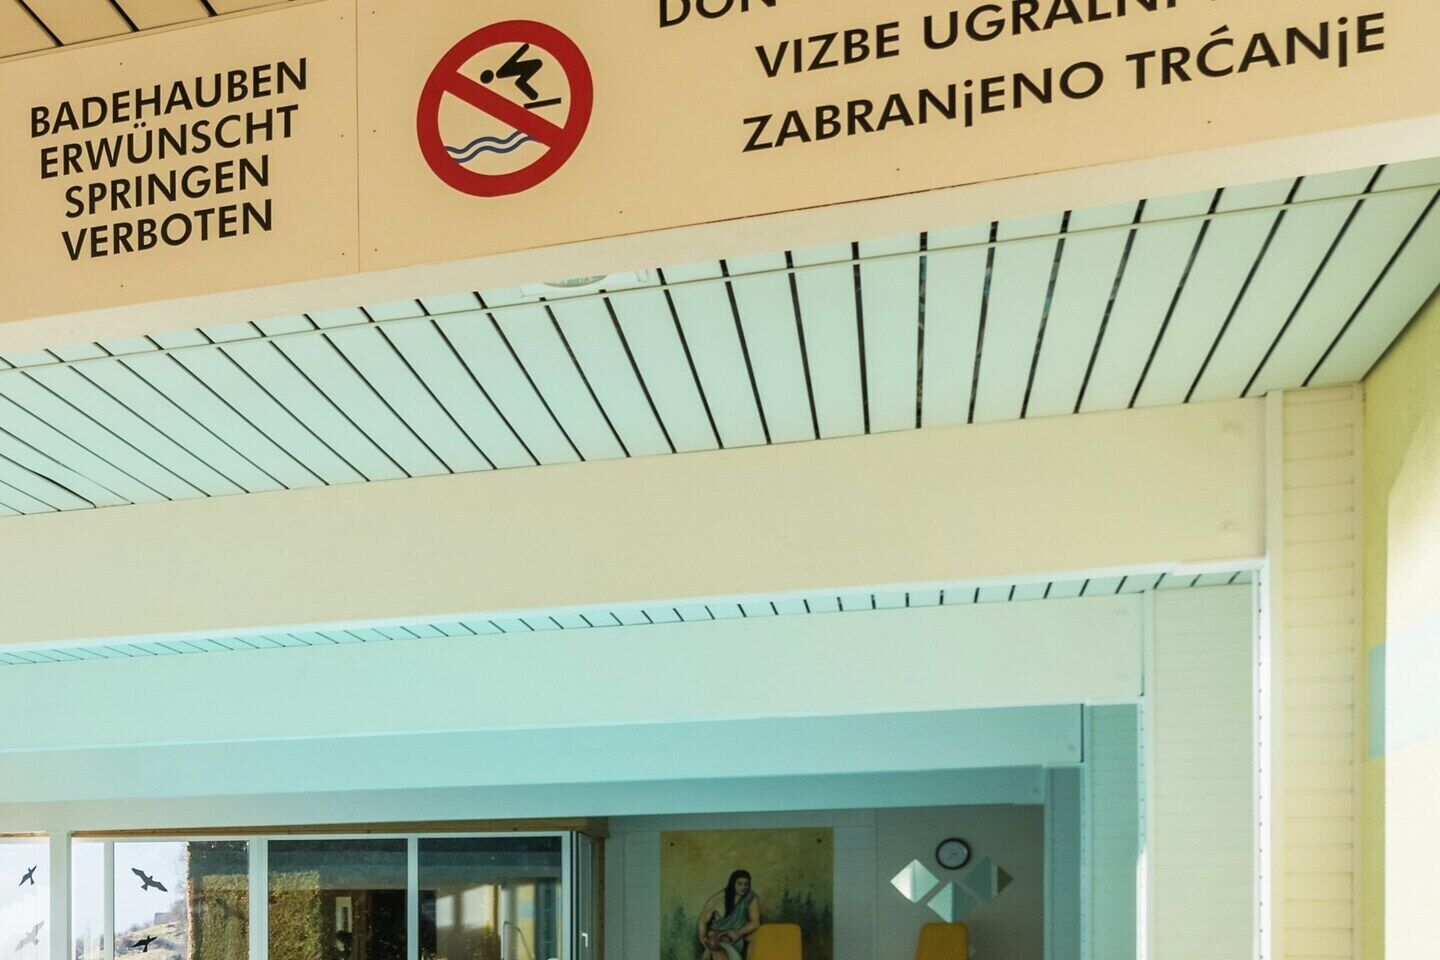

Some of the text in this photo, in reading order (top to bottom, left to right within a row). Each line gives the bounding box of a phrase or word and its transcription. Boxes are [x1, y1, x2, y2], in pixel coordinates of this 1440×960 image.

[754, 21, 900, 78] VIZBE
[31, 57, 307, 139] BADEHAUBEN
[40, 104, 299, 180] ERWÜNSCHT
[65, 154, 270, 219] SPRINGEN
[61, 198, 272, 261] VERBOTEN
